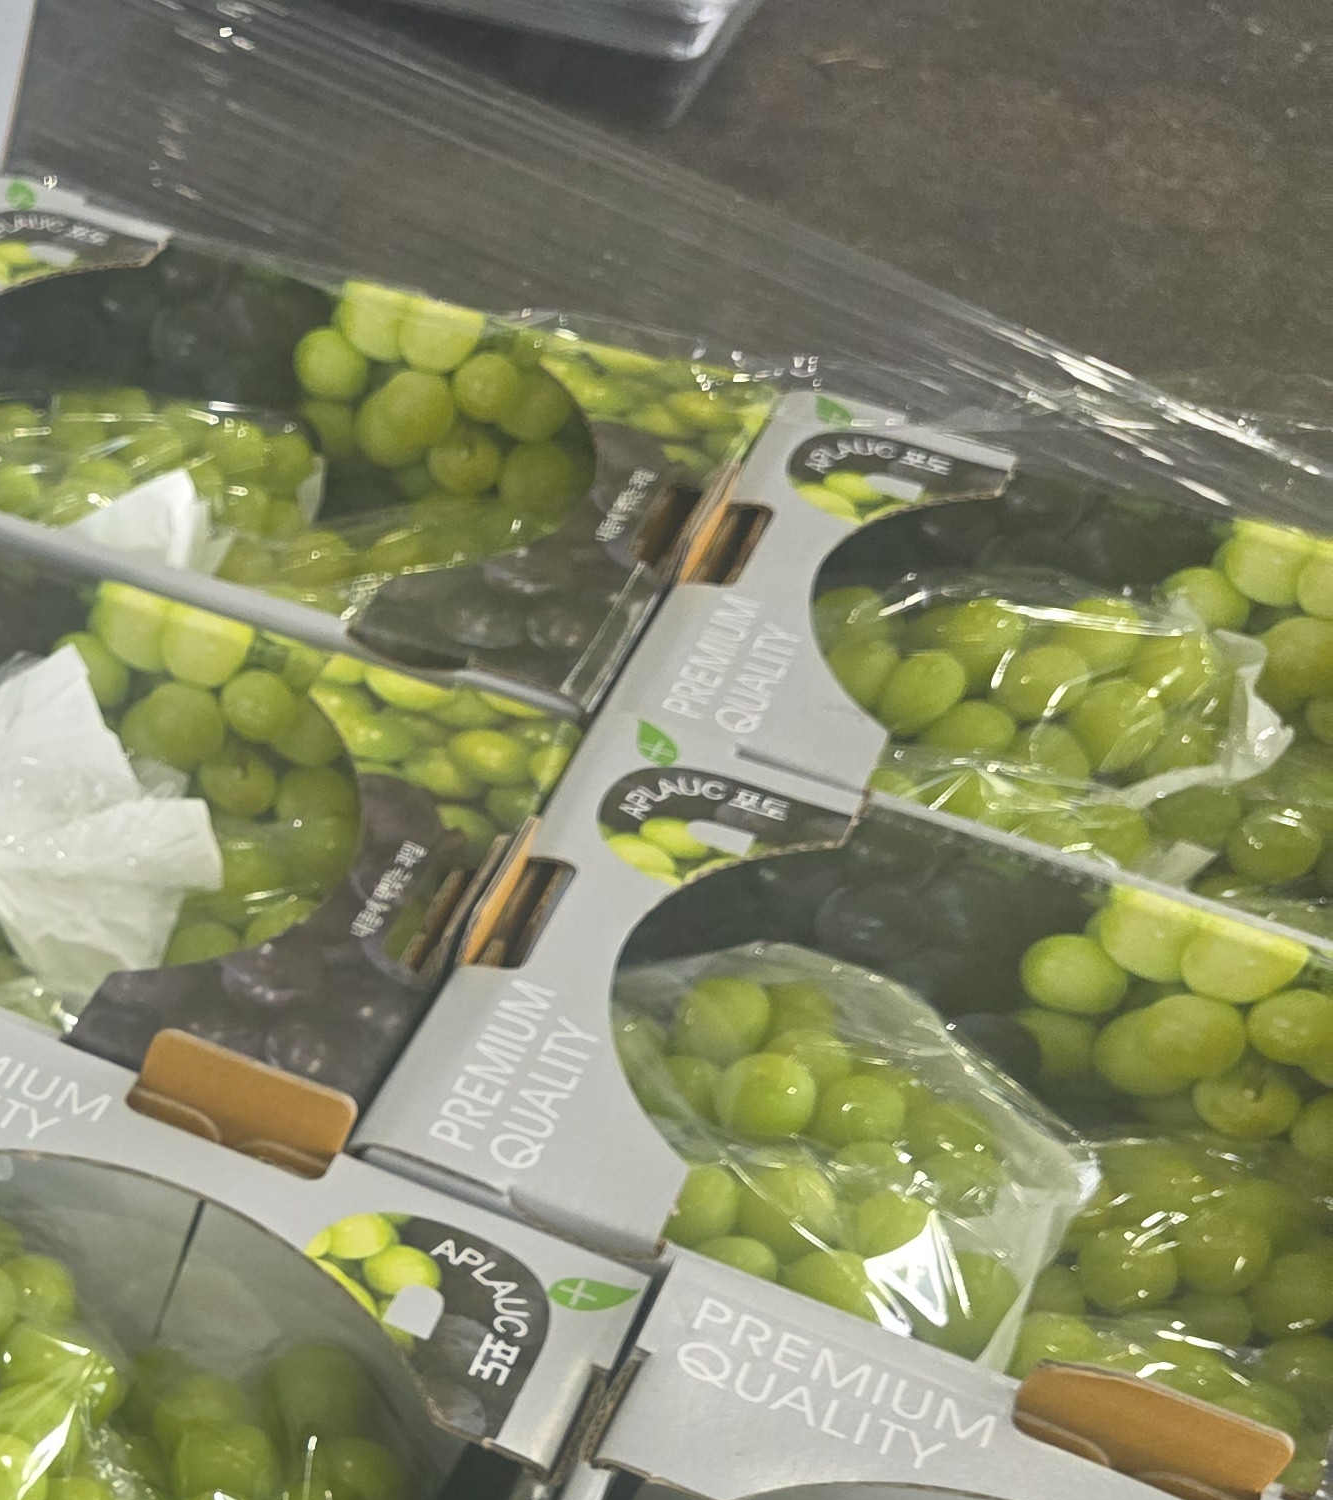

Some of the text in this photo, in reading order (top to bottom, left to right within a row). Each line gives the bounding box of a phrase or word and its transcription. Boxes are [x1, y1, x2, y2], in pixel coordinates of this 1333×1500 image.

[661, 593, 764, 721] PREMIUM
[714, 621, 804, 734] QUALITY
[618, 776, 728, 821] APLAUC
[428, 979, 559, 1151] PREMIUM
[489, 1015, 601, 1170] QUALITY
[429, 1238, 532, 1386] APLAUC 포도
[691, 1296, 997, 1448] PREMIUM
[676, 1342, 948, 1469] QUALITY
